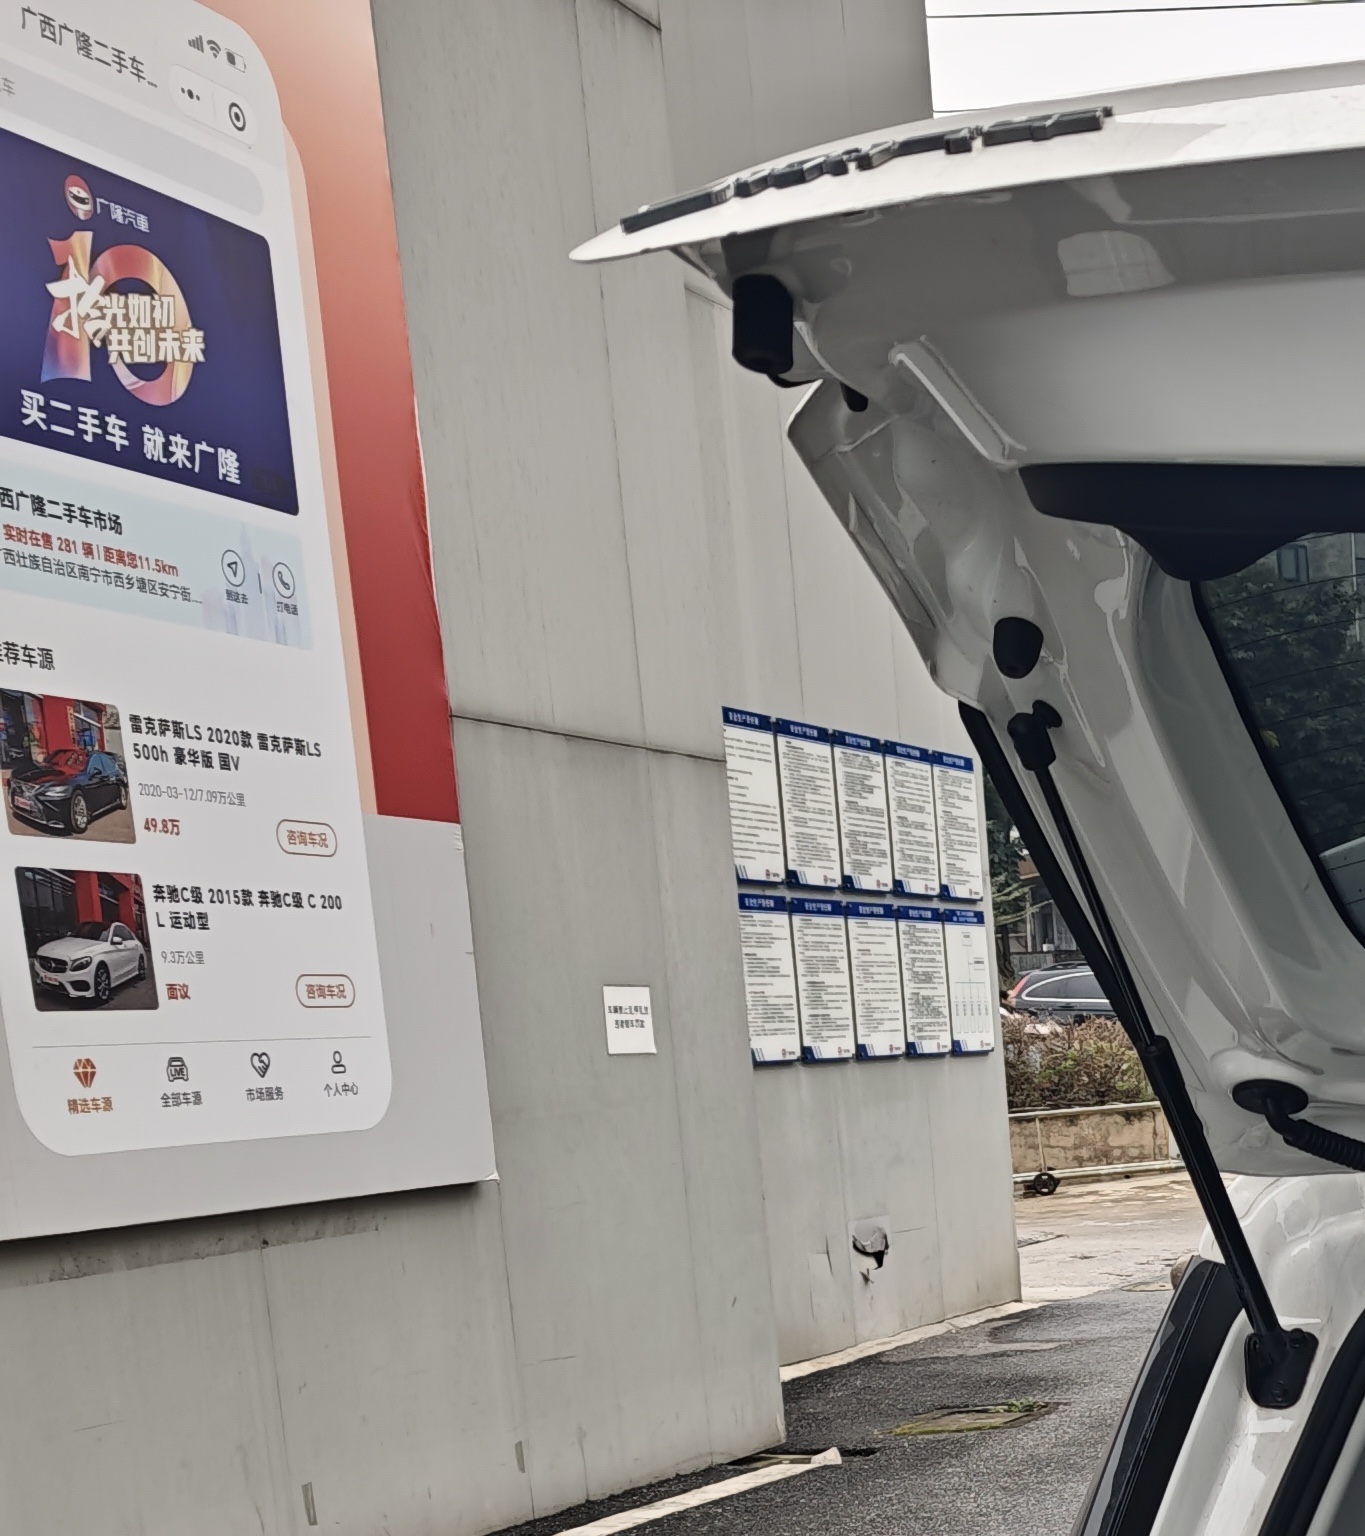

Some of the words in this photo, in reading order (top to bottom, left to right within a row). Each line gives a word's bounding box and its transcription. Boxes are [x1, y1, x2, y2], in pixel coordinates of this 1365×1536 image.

[107, 328, 206, 364] 共创未来
[20, 389, 130, 452] 买二手车
[141, 423, 242, 485] 就来广隆
[2, 523, 54, 551] 实时在售
[56, 536, 78, 555] 281
[128, 713, 203, 742] 雷克萨斯LS
[206, 727, 254, 750] 2020款
[256, 732, 323, 758] 雷克萨斯LS
[132, 743, 170, 764] 500h
[173, 746, 215, 770] 豪华版
[217, 751, 240, 772] 国V
[143, 817, 181, 837] 49.8万
[286, 829, 330, 849] 咨询车况
[152, 884, 205, 905] 奔驰C级
[208, 888, 255, 907] 2015款
[257, 890, 305, 910] 奔驰C级
[307, 893, 317, 909] C
[320, 894, 343, 911] 200
[155, 911, 166, 929] L
[168, 911, 211, 931] 运动型
[165, 982, 192, 1001] 面议
[305, 983, 348, 1001] 咨询车况
[245, 1086, 285, 1102] 市场服务
[323, 1082, 359, 1098] 个人中心
